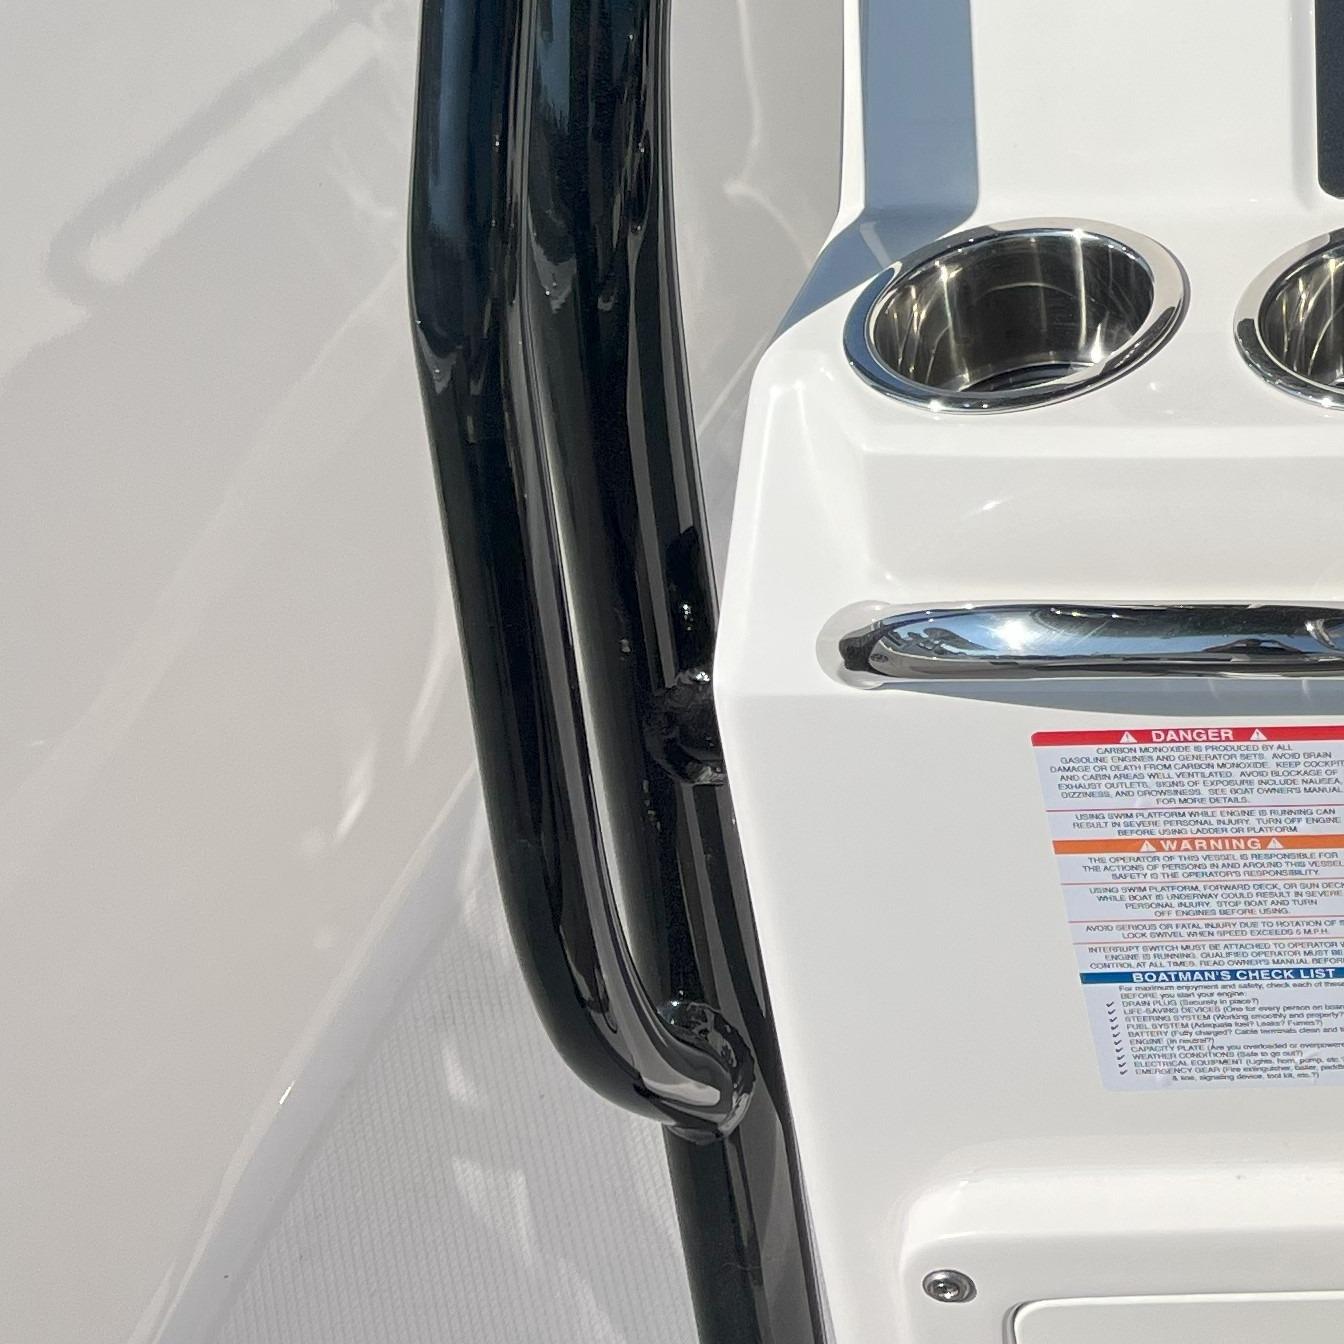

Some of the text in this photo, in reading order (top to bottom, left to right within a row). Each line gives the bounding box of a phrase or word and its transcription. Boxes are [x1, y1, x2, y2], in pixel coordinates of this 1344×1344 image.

[1152, 729, 1234, 742] DANGER
[1160, 838, 1262, 851] WARNING
[1132, 966, 1335, 982] BOATMAN'S CHECK LIST
